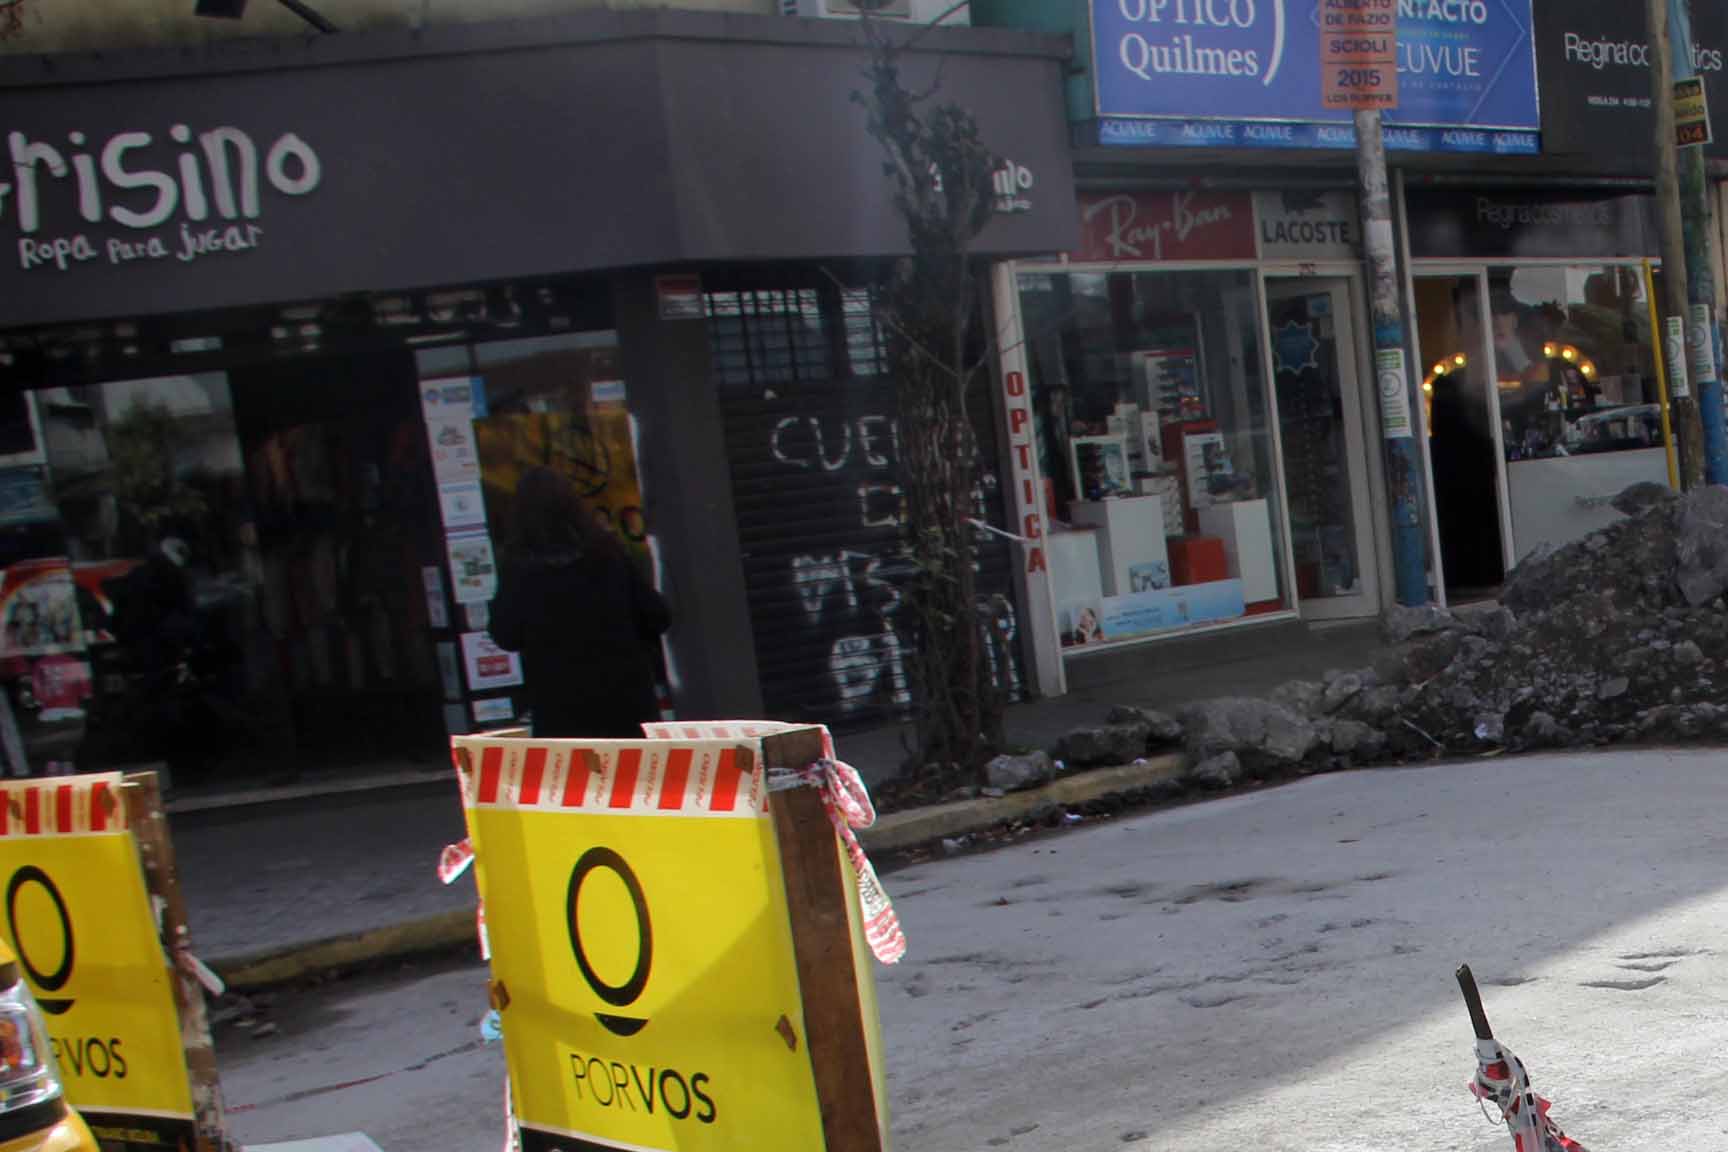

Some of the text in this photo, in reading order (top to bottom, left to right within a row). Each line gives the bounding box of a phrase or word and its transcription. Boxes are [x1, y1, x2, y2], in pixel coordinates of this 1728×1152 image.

[1397, 0, 1488, 24] NTACTO
[1119, 32, 1260, 81] Quilmes
[1329, 39, 1388, 54] SCIOLI
[1396, 41, 1481, 77] CUVUE
[1337, 68, 1382, 87] 2015
[0, 123, 321, 234] risino
[1263, 219, 1350, 244] LACOSTE
[18, 236, 96, 270] Ropa
[1004, 370, 1047, 574] OPTICA
[569, 1053, 717, 1124] PORVOS
